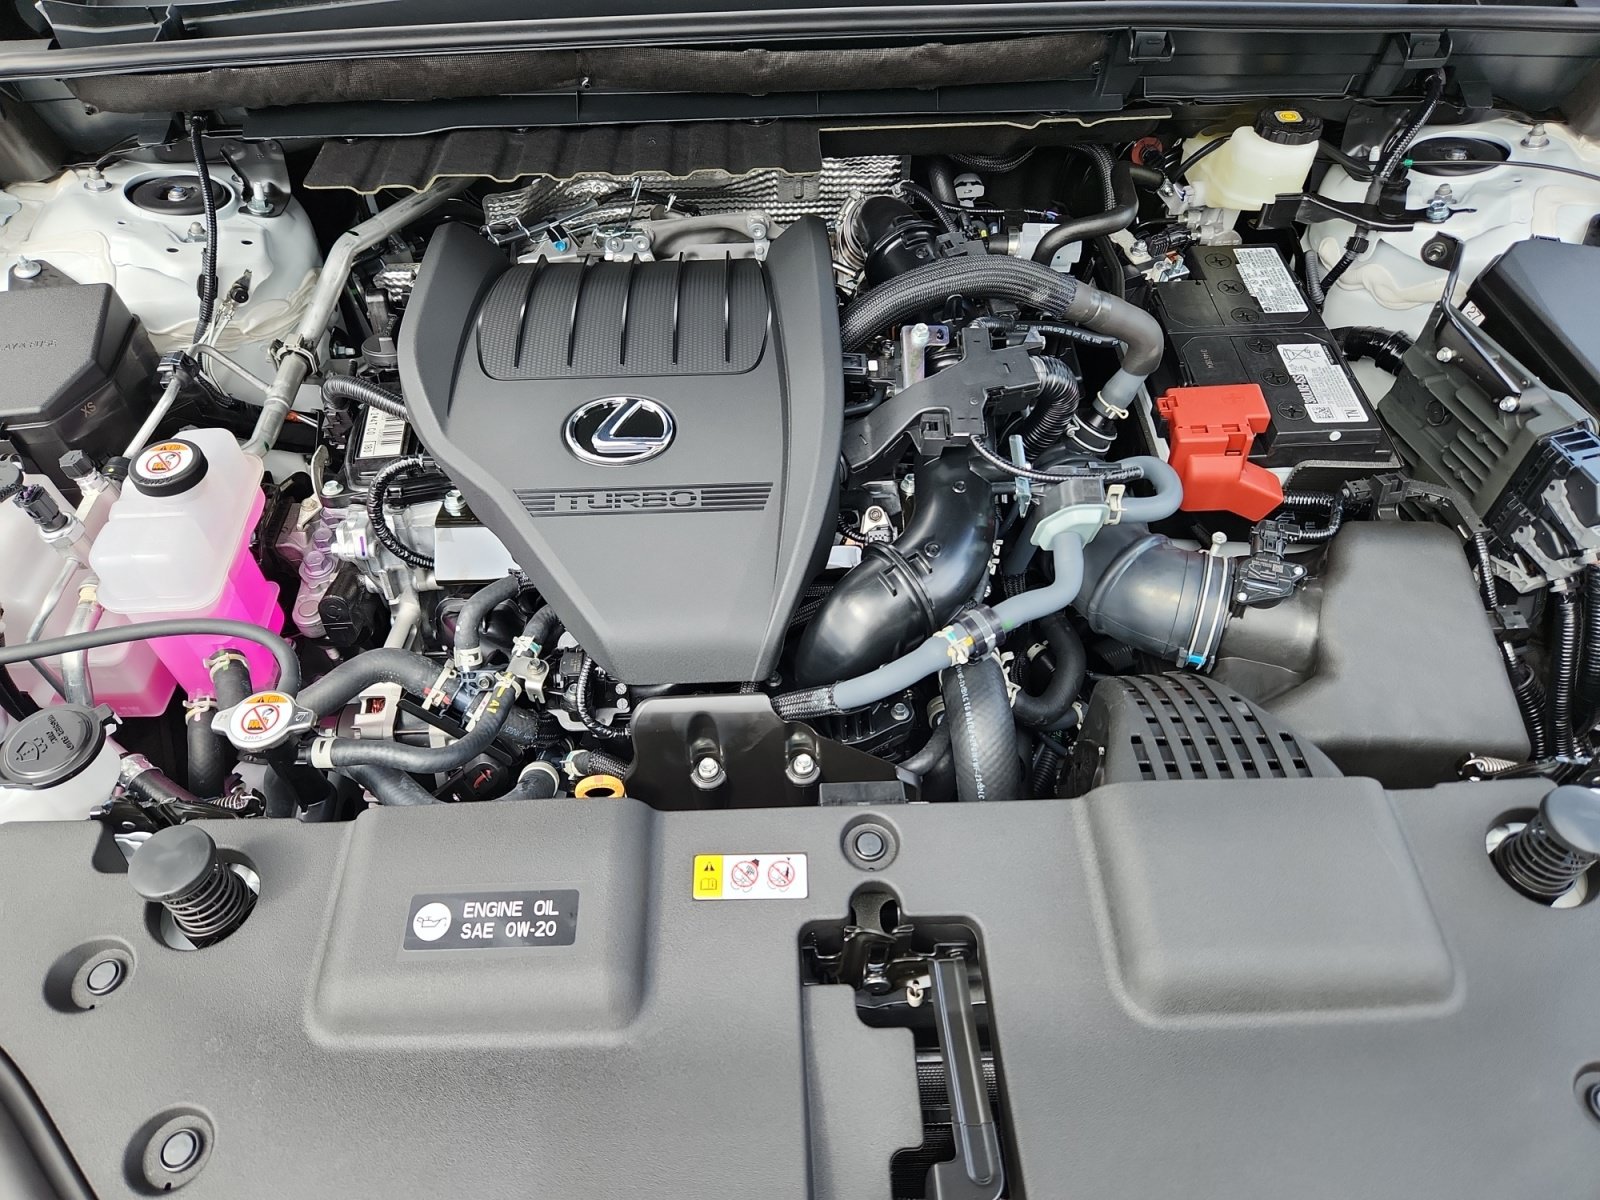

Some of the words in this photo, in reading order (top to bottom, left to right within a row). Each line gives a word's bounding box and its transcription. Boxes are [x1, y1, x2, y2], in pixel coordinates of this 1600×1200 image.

[1466, 305, 1482, 321] 27
[559, 489, 699, 511] TURBO
[462, 900, 524, 919] ENGINE
[533, 899, 560, 916] OIL
[460, 922, 495, 939] SAE
[505, 920, 557, 938] 0W-20
